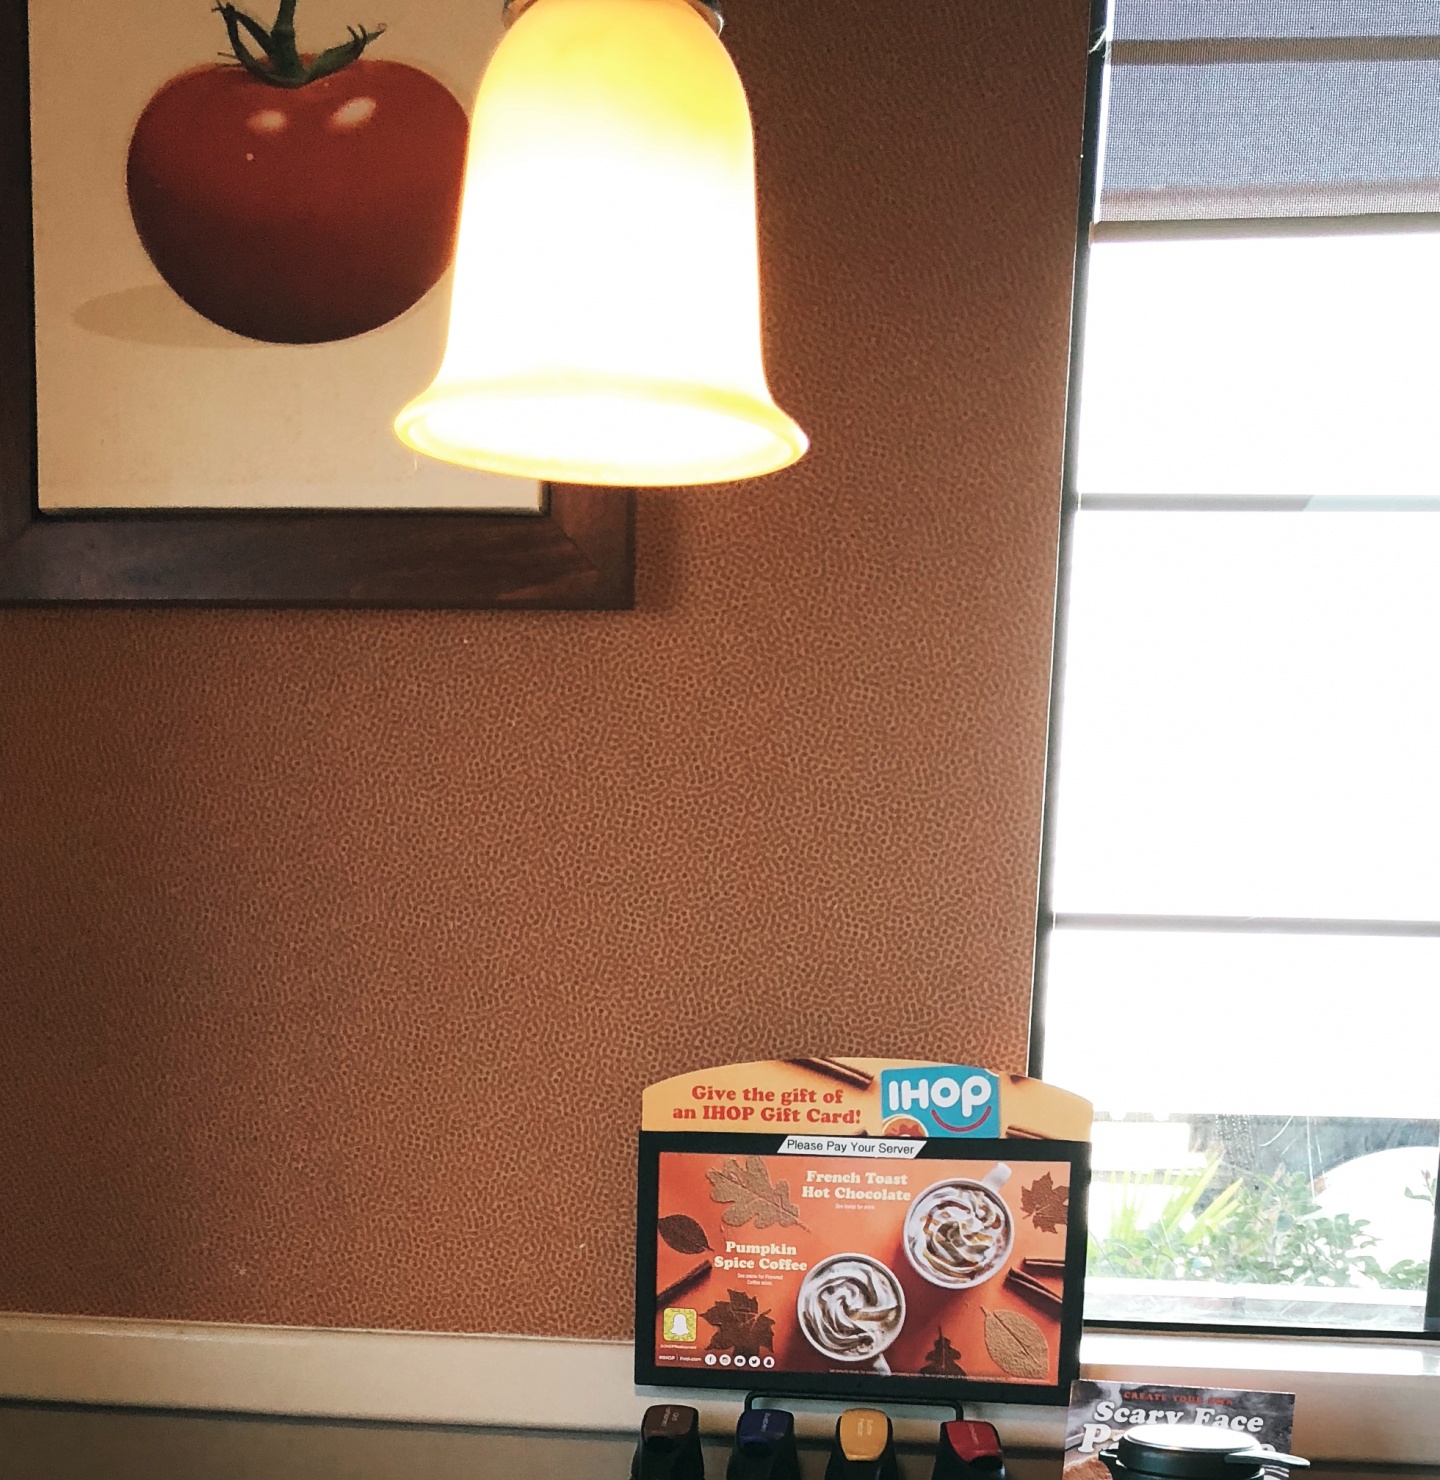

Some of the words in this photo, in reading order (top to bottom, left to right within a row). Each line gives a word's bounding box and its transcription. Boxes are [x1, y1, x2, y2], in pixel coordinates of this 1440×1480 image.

[692, 1085, 736, 1101] Give
[743, 1087, 775, 1102] the
[781, 1088, 817, 1106] gift
[822, 1089, 844, 1104] of
[888, 1075, 992, 1118] IHOP
[672, 1107, 696, 1120] an
[702, 1105, 755, 1121] IHOP
[760, 1107, 801, 1123] Gift
[806, 1108, 862, 1124] Card!
[786, 1139, 824, 1152] Please
[826, 1140, 848, 1154] Pay
[850, 1142, 876, 1153] Your
[878, 1143, 915, 1155] Server
[806, 1170, 861, 1184] French
[865, 1172, 909, 1186] Toast
[801, 1186, 830, 1199] Hot
[834, 1187, 912, 1201] Chocolate
[725, 1240, 797, 1256] Pumpkin
[713, 1256, 755, 1271] Spice
[759, 1258, 808, 1271] Coffee
[1123, 1391, 1167, 1403] CREATE
[1171, 1394, 1204, 1405] YOUR
[1093, 1401, 1184, 1425] Scary
[1193, 1407, 1264, 1432] Face
